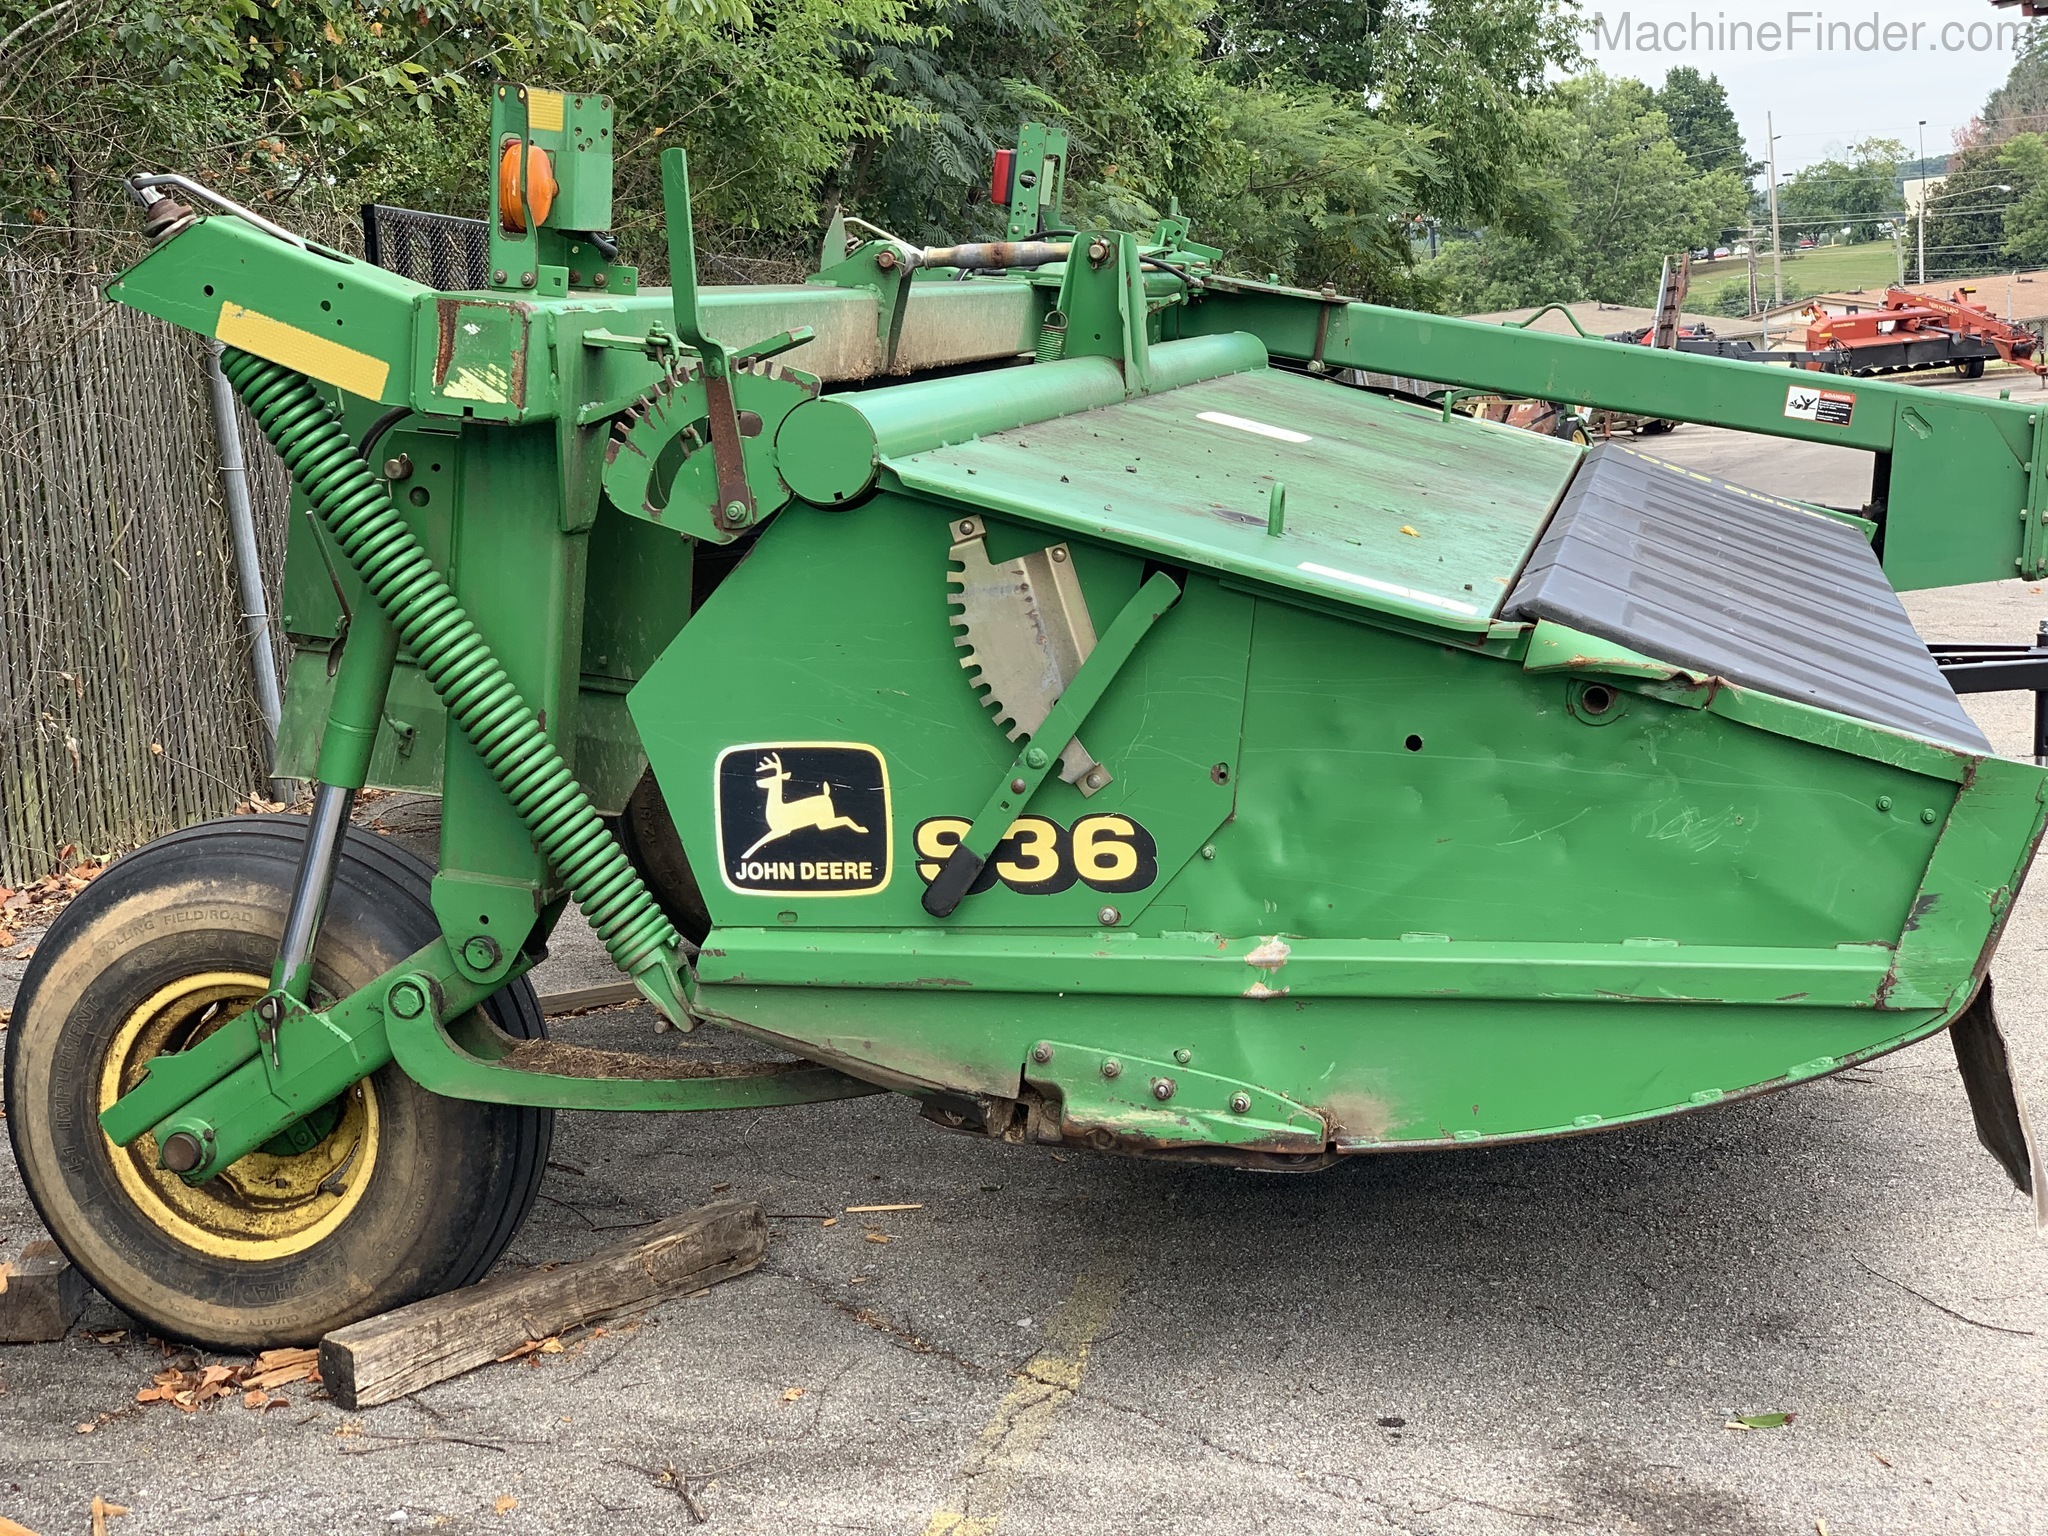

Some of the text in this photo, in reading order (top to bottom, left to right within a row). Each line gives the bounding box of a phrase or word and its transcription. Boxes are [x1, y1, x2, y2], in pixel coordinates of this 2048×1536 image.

[735, 861, 873, 881] JOHN DEERE
[163, 909, 254, 925] FIELD/ROAD
[54, 993, 102, 1132] IMPLEMENT
[399, 1176, 432, 1240] PRODUCED
[251, 1262, 337, 1302] ALPHA
[246, 1312, 301, 1327] QUALITY
